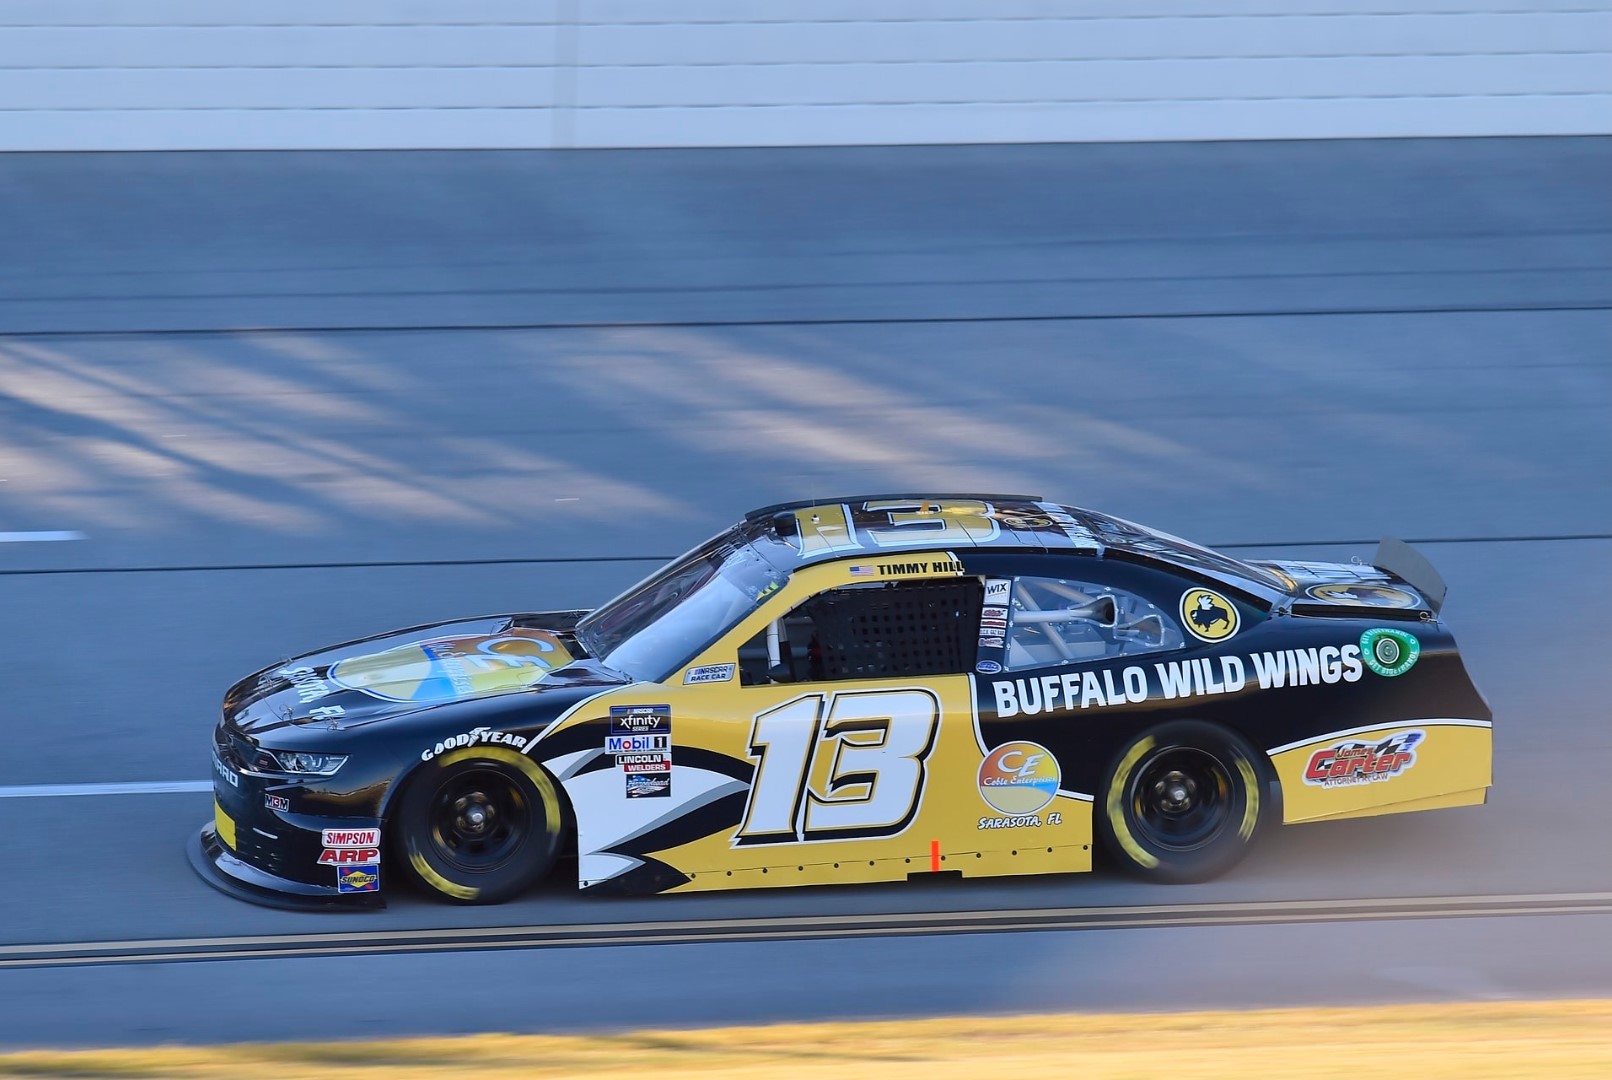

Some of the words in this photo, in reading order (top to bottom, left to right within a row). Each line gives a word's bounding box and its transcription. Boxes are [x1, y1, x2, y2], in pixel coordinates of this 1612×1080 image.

[877, 563, 928, 575] TIMMY
[932, 561, 965, 573] HILL
[987, 583, 1007, 594] WIX
[698, 665, 728, 675] NASCAR
[992, 666, 1149, 717] BUFFALO
[1154, 656, 1246, 699] WILD
[1249, 644, 1363, 690] WINGS
[620, 715, 661, 729] xfinity
[421, 728, 527, 761] GOODYEAR
[609, 737, 649, 750] Mobil
[656, 737, 665, 748] 1
[618, 755, 662, 764] LINCOLN
[997, 750, 1044, 777] CE
[1306, 750, 1411, 779] Carter
[627, 764, 666, 772] WELDERS
[729, 686, 943, 849] 13
[1324, 777, 1362, 786] ATTORNEY
[1372, 773, 1389, 781] LAW
[978, 816, 1042, 830] SARASOTA,
[1047, 812, 1062, 825] FL
[326, 832, 375, 844] SIMPSON
[320, 849, 378, 862] ARP
[341, 875, 376, 883] SUNOCO
